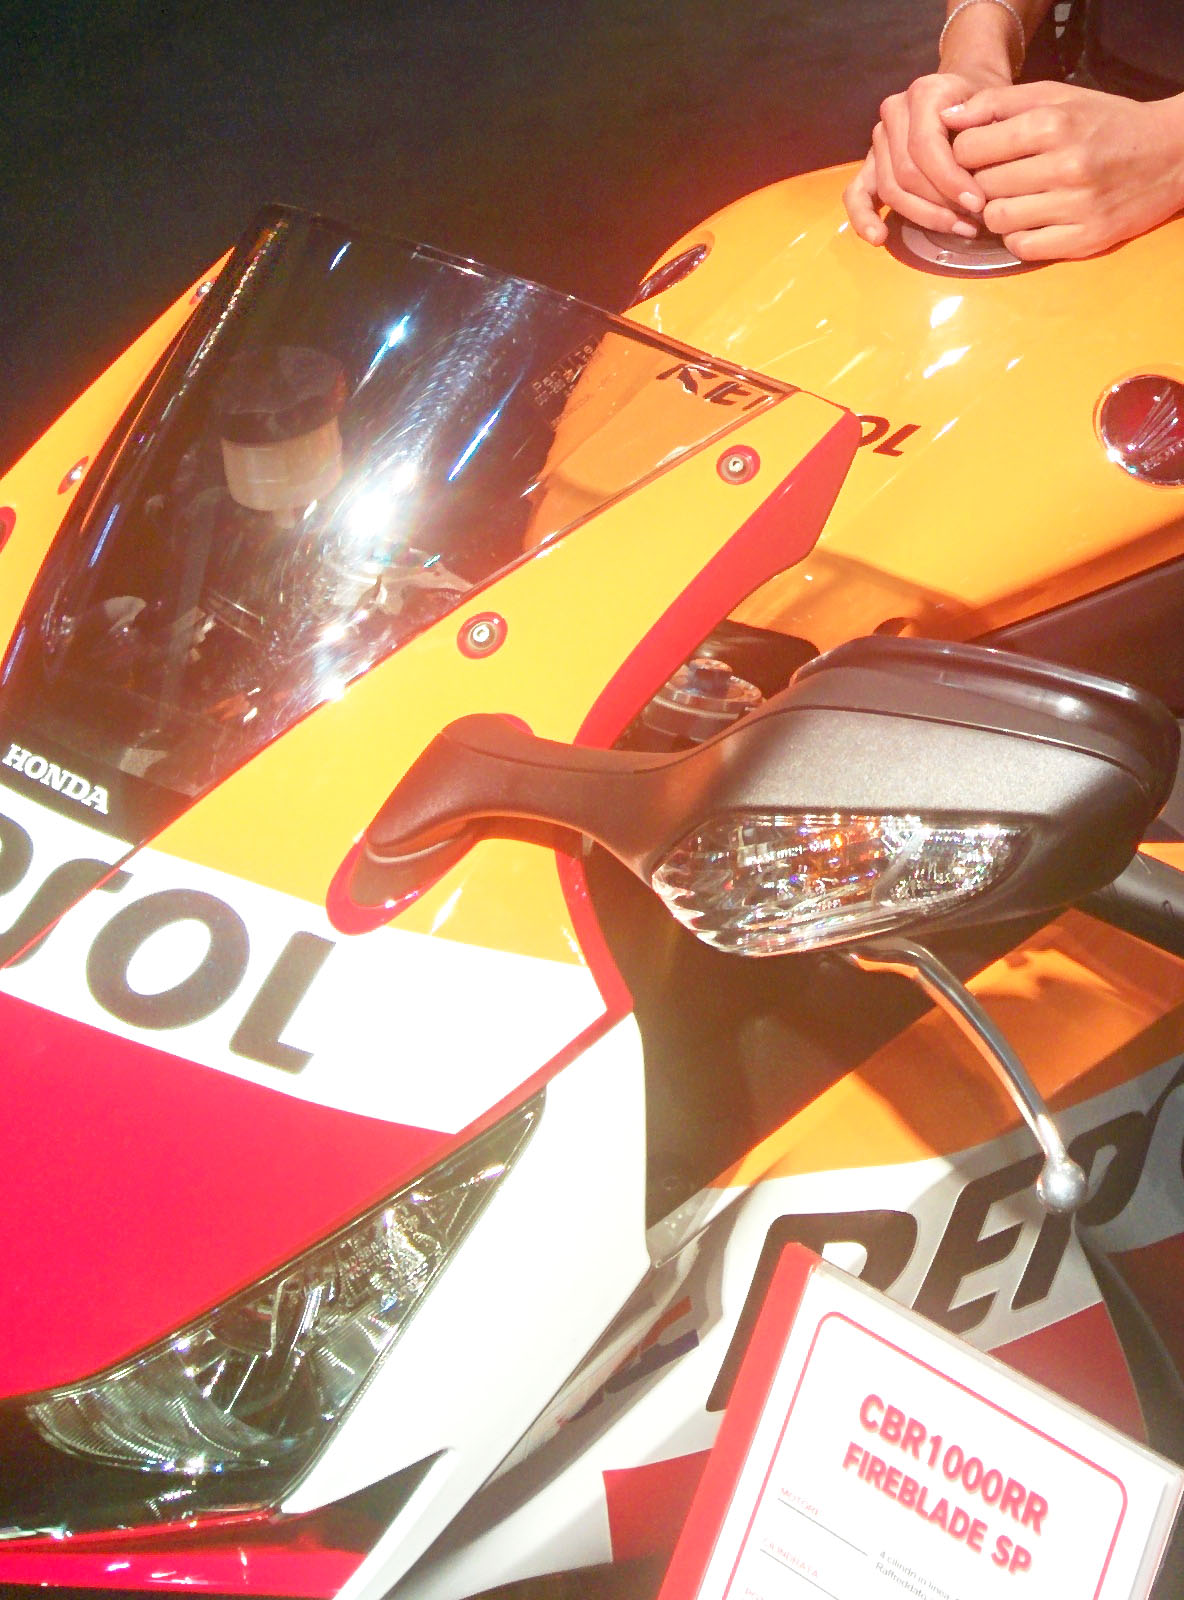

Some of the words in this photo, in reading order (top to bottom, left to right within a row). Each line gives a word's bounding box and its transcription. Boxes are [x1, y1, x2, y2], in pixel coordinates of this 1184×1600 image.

[2, 743, 110, 815] HONDA
[842, 1441, 989, 1553] FIREBLADE
[991, 1534, 1033, 1575] SP
[859, 1393, 1049, 1536] CBR1000RR
